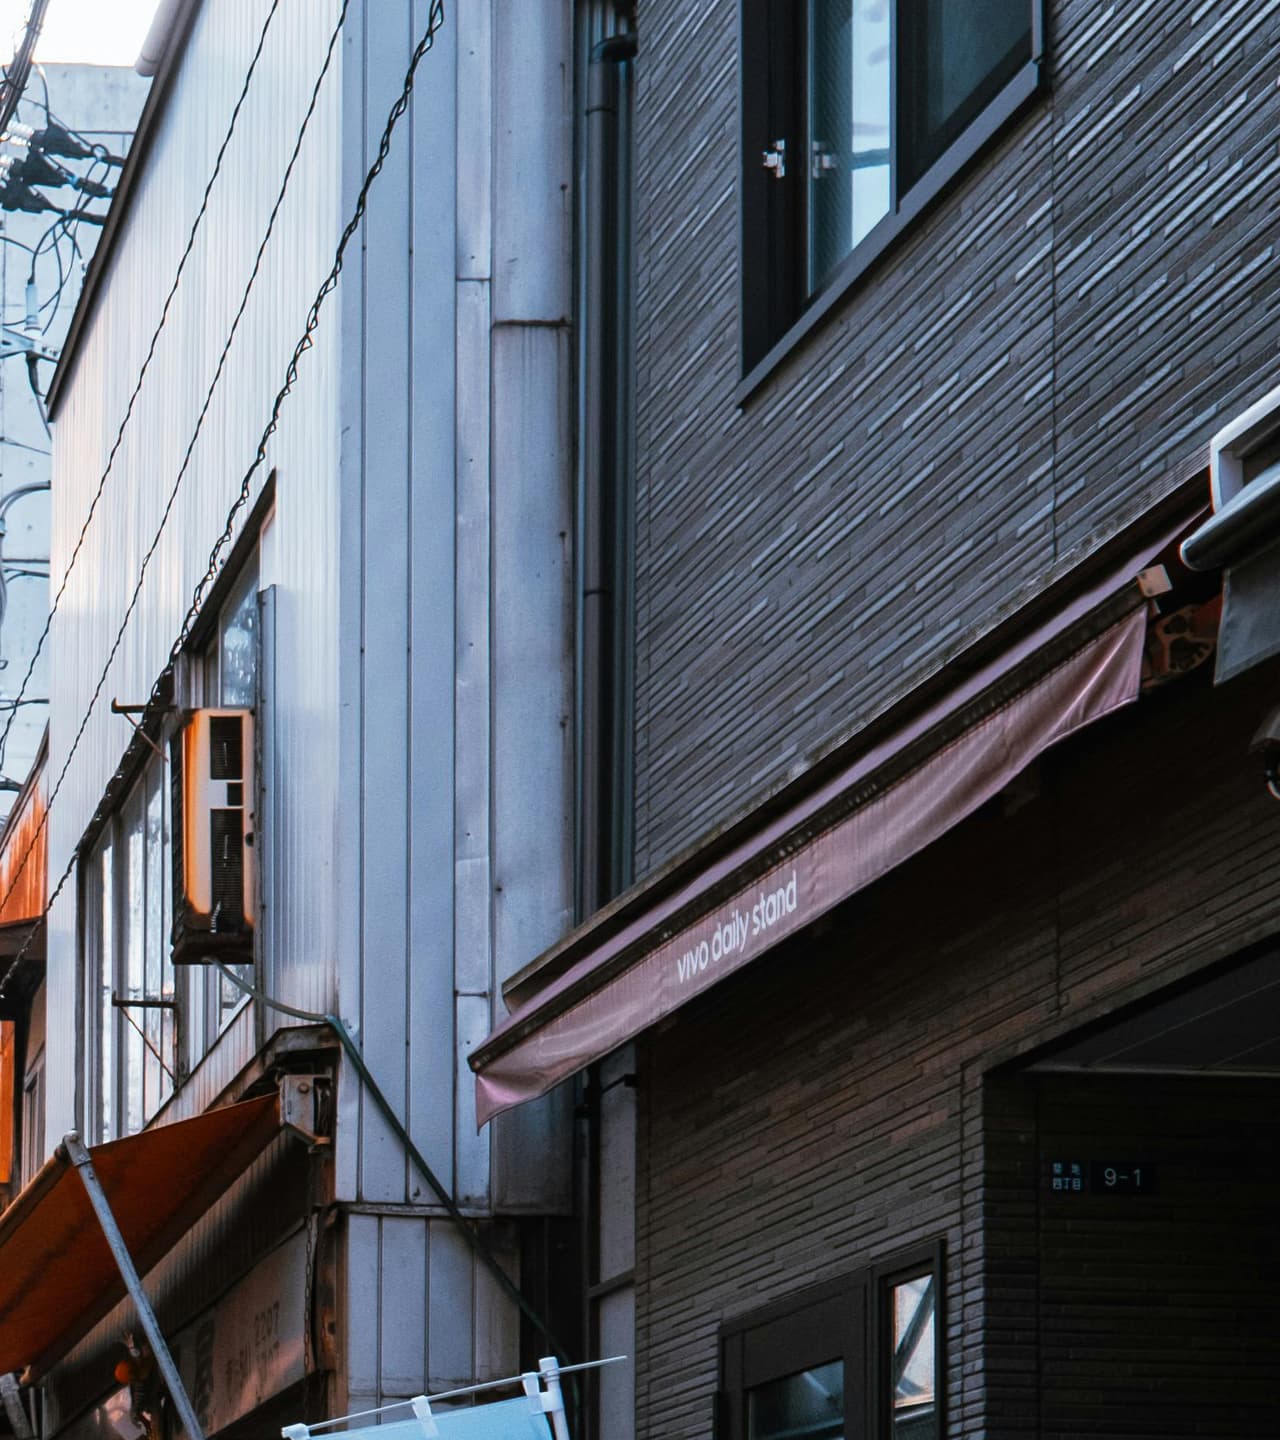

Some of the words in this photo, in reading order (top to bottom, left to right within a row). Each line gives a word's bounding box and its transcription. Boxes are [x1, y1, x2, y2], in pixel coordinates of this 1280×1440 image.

[677, 941, 709, 984] vivo
[711, 909, 749, 962] daily
[752, 869, 797, 935] stand
[1104, 1167, 1141, 1186] 9-1
